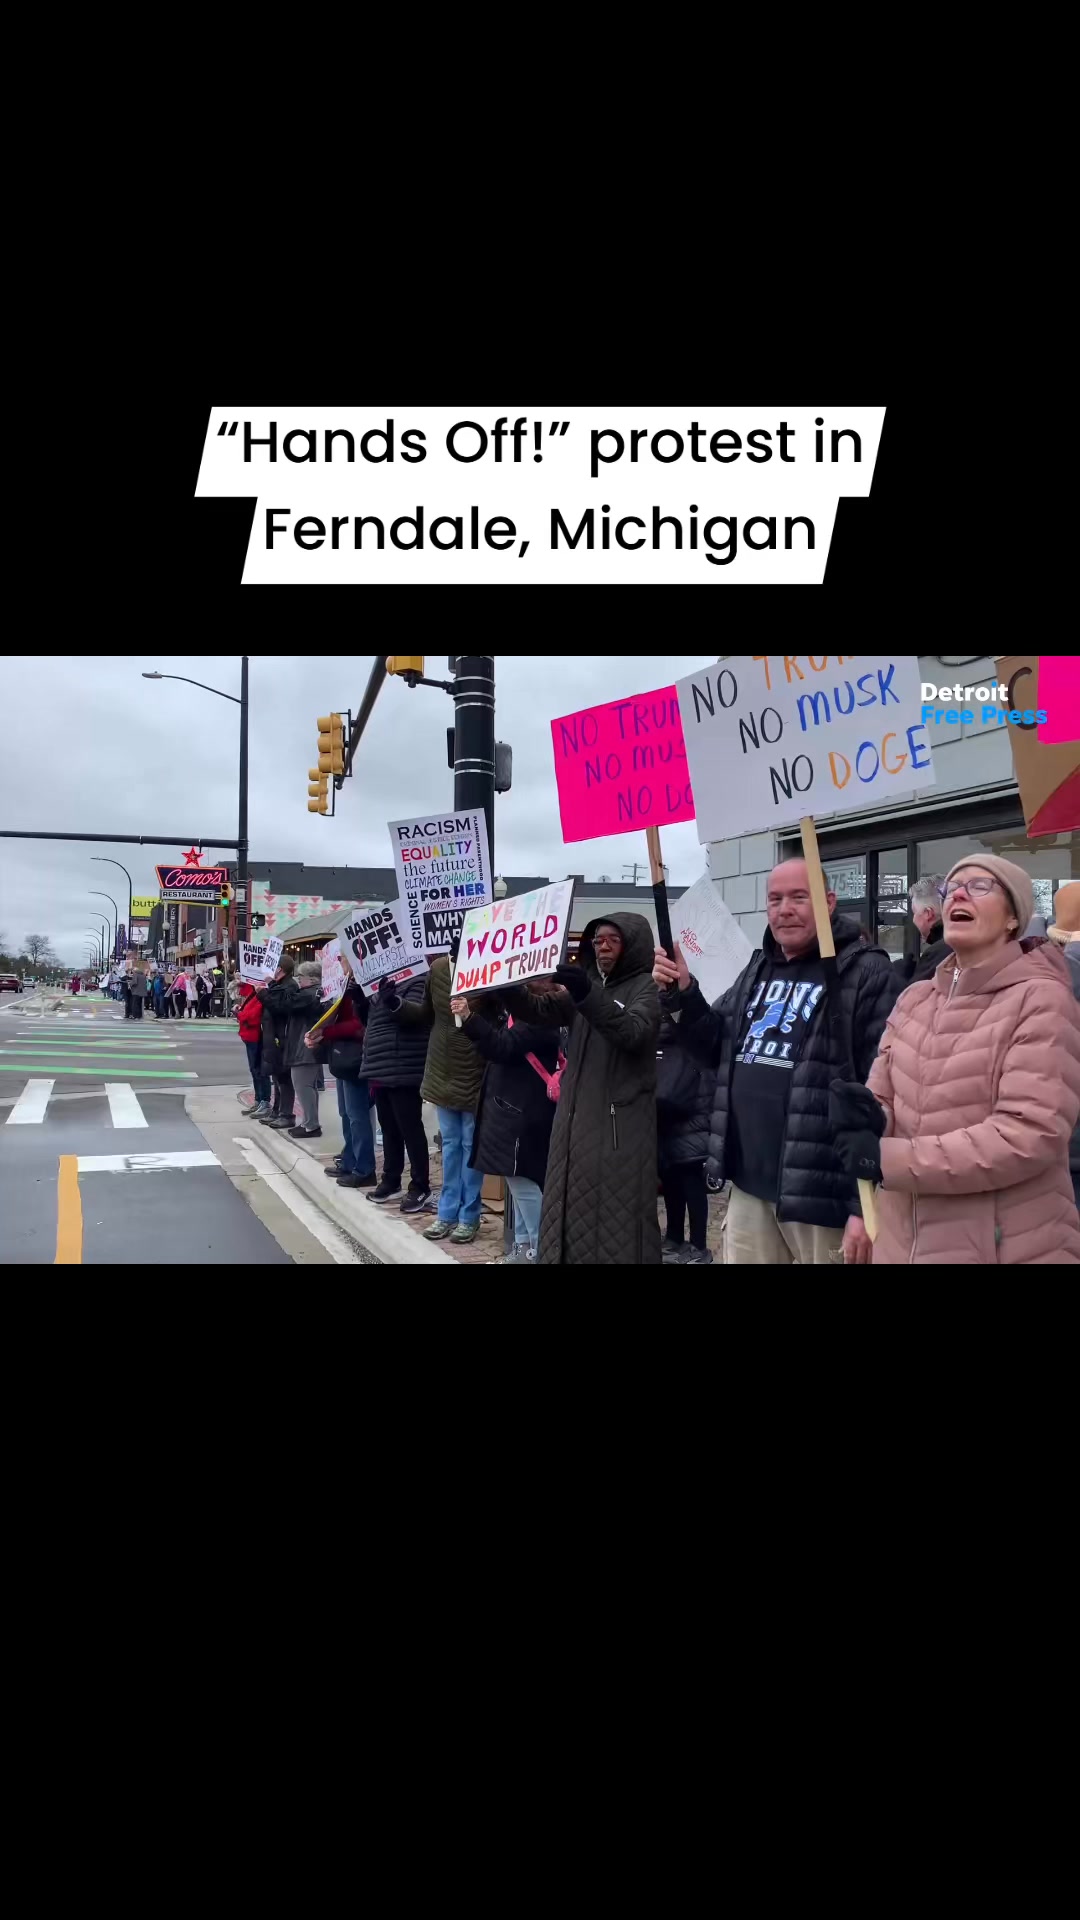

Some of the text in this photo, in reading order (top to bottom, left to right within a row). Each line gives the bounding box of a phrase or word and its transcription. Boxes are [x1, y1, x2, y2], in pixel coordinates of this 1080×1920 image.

[691, 656, 855, 724] NO TRU
[738, 663, 901, 754] NO MUSK
[560, 713, 598, 757] NO
[585, 753, 622, 788] NO
[768, 724, 932, 805] NO DOGE
[617, 785, 653, 823] NO
[397, 817, 471, 841] RACISM
[401, 840, 472, 862] EQUALITY
[403, 858, 476, 877] the future
[164, 868, 223, 887] Como's
[404, 870, 477, 890] CLIMATE CHANGE
[420, 882, 486, 902] FOR HER
[132, 899, 159, 908] butt
[162, 891, 214, 899] RESTAURANT
[460, 896, 486, 907] RIGHTS
[523, 885, 565, 918] THE
[344, 907, 393, 941] HANDS
[407, 891, 422, 949] SCIENCE
[243, 943, 267, 955] HANDS
[352, 921, 403, 961] OFF!
[466, 914, 559, 960] WORLD
[456, 943, 559, 992] DUMP TRUMP
